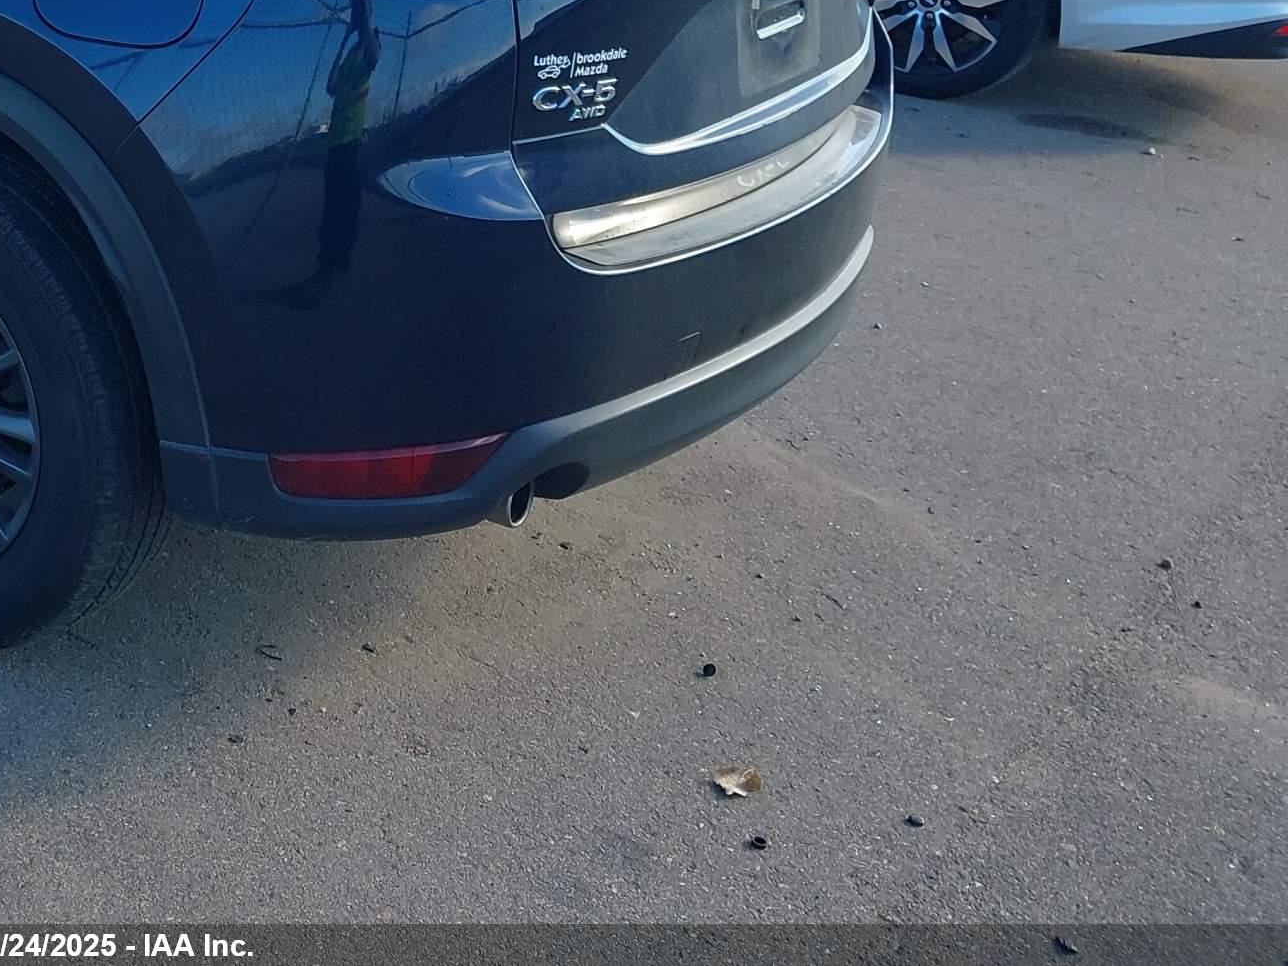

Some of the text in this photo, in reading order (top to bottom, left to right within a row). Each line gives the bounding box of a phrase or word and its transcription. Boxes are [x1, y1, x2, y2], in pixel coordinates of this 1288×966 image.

[534, 47, 628, 67] Luther brookdale
[574, 63, 609, 77] Mazda
[532, 78, 618, 111] CX-5
[568, 104, 606, 122] AWD
